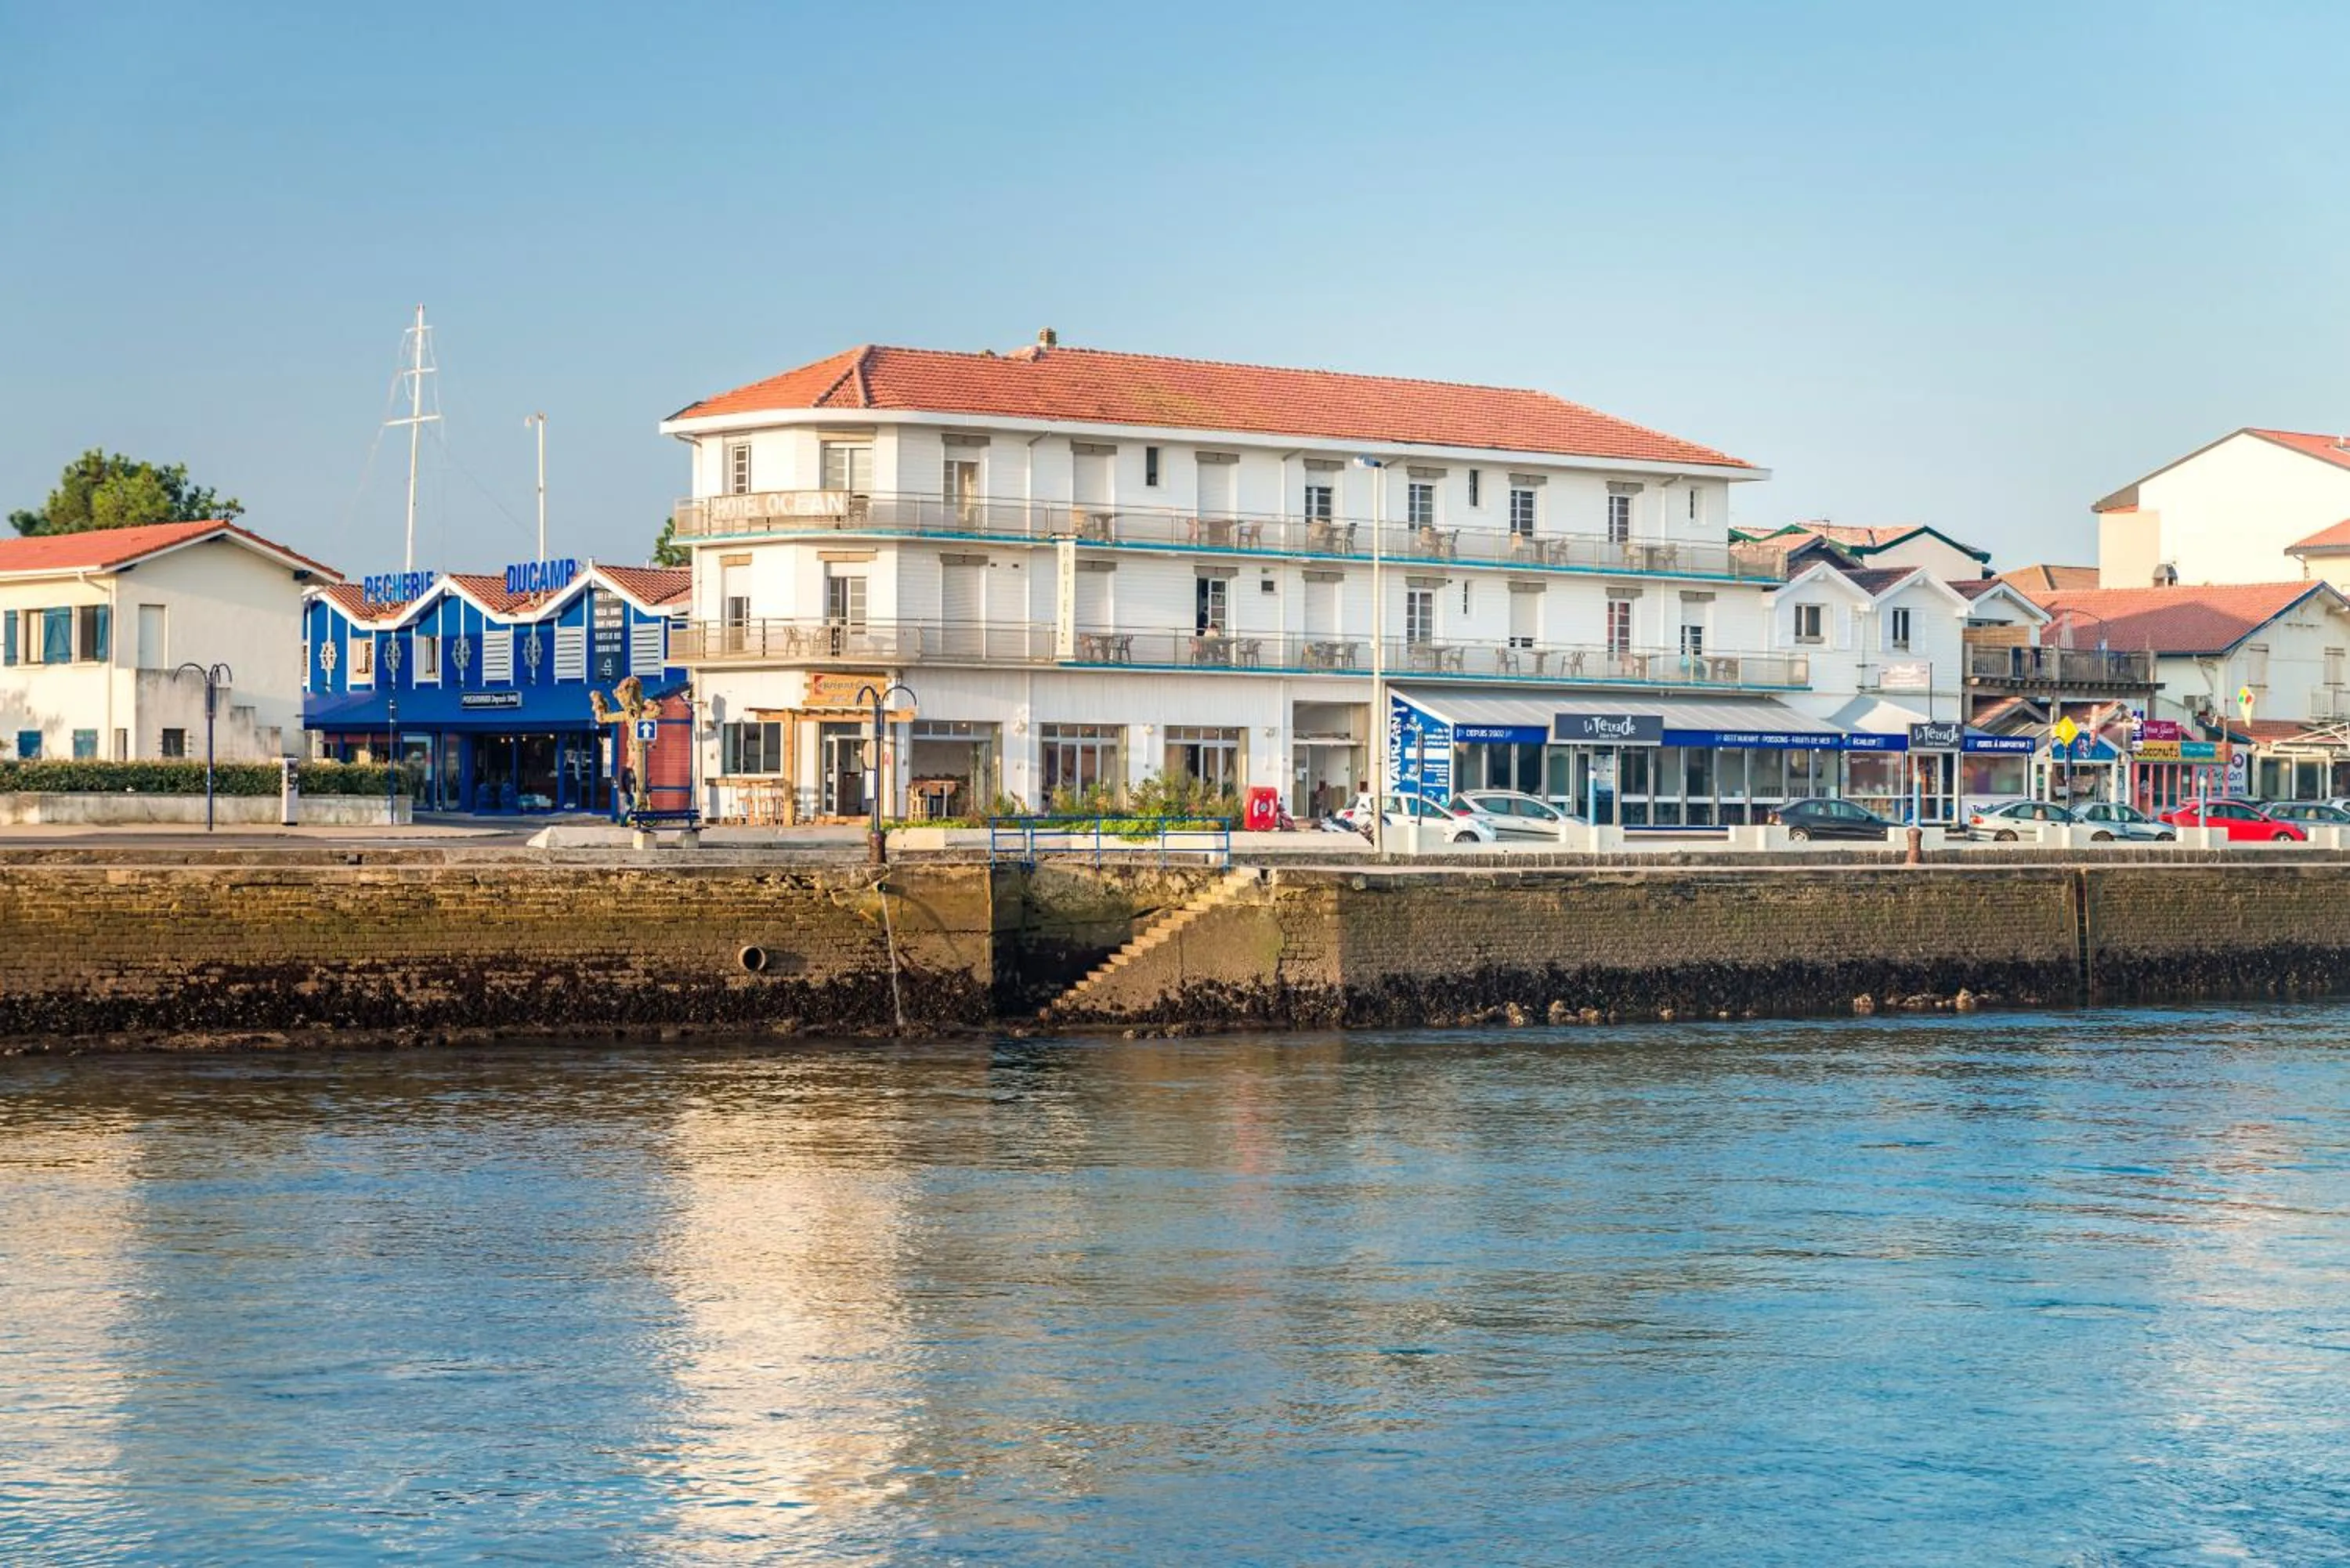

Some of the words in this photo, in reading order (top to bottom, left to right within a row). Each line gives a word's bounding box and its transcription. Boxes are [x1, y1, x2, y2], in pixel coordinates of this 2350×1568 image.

[714, 497, 758, 519] HOTEL
[766, 492, 844, 517] OCEAN
[363, 571, 435, 603] PECHERIE
[506, 558, 577, 594] DUCAMP
[1466, 729, 1488, 738] DEPUIS
